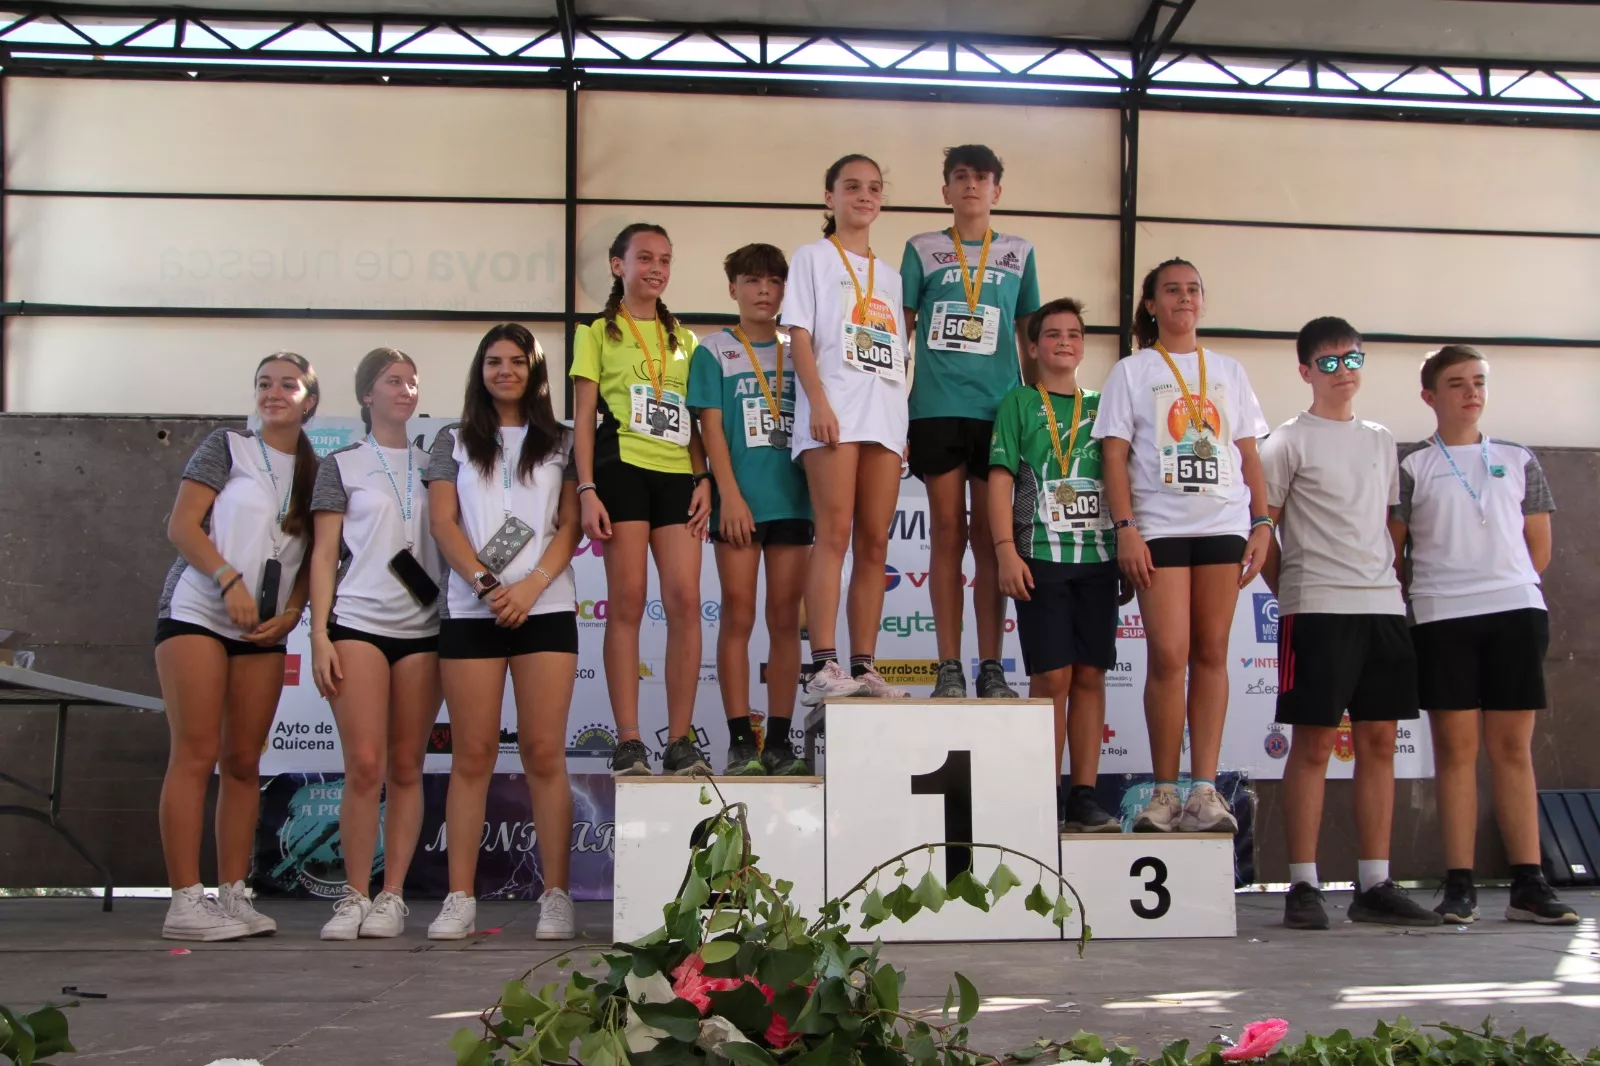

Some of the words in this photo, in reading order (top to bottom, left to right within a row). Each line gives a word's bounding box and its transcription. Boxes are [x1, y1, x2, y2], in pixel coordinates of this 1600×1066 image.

[945, 319, 968, 336] 50
[858, 346, 891, 364] 506
[1180, 460, 1216, 479] 515
[1066, 495, 1099, 516] 503
[1254, 658, 1278, 668] INTE
[275, 722, 310, 737] Ayto
[314, 722, 333, 734] de
[578, 730, 595, 746] EURO
[597, 730, 614, 746] NIVEL
[272, 738, 335, 751] Quicena
[1108, 748, 1128, 756] Roja
[1394, 745, 1415, 754] ena
[911, 751, 974, 887] 1
[296, 874, 342, 894] MONTEAR
[1129, 856, 1171, 920] 3
